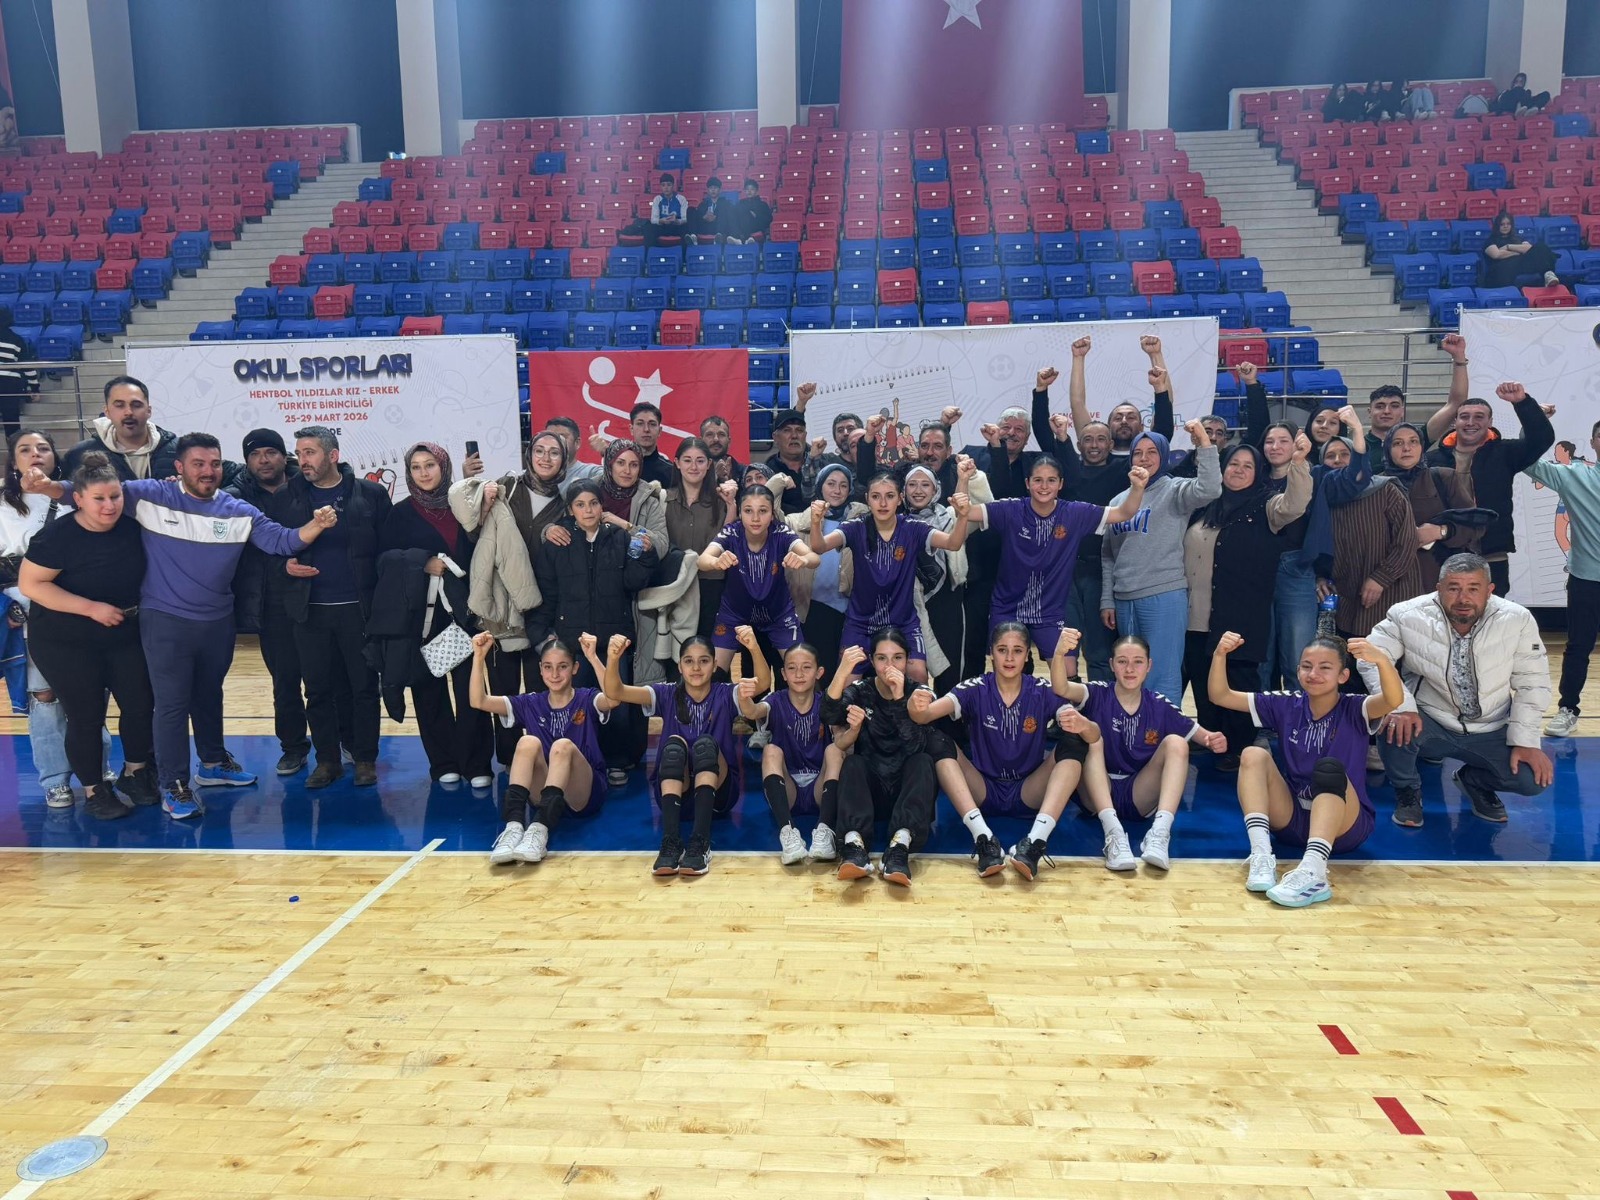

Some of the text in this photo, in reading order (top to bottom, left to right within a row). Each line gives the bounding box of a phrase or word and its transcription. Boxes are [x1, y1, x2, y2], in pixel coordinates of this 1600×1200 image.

[234, 353, 412, 382] OKUL SPORLARI
[250, 389, 292, 398] HENTBOL
[295, 388, 343, 397] YILDIZLAR
[346, 387, 360, 396] KIZ
[370, 386, 399, 395] ERKEK
[278, 398, 373, 410] TÜRKİYE BİRİNCİLİĞİ
[314, 413, 340, 421] MART
[343, 412, 369, 420] 2026
[788, 625, 798, 641] 7
